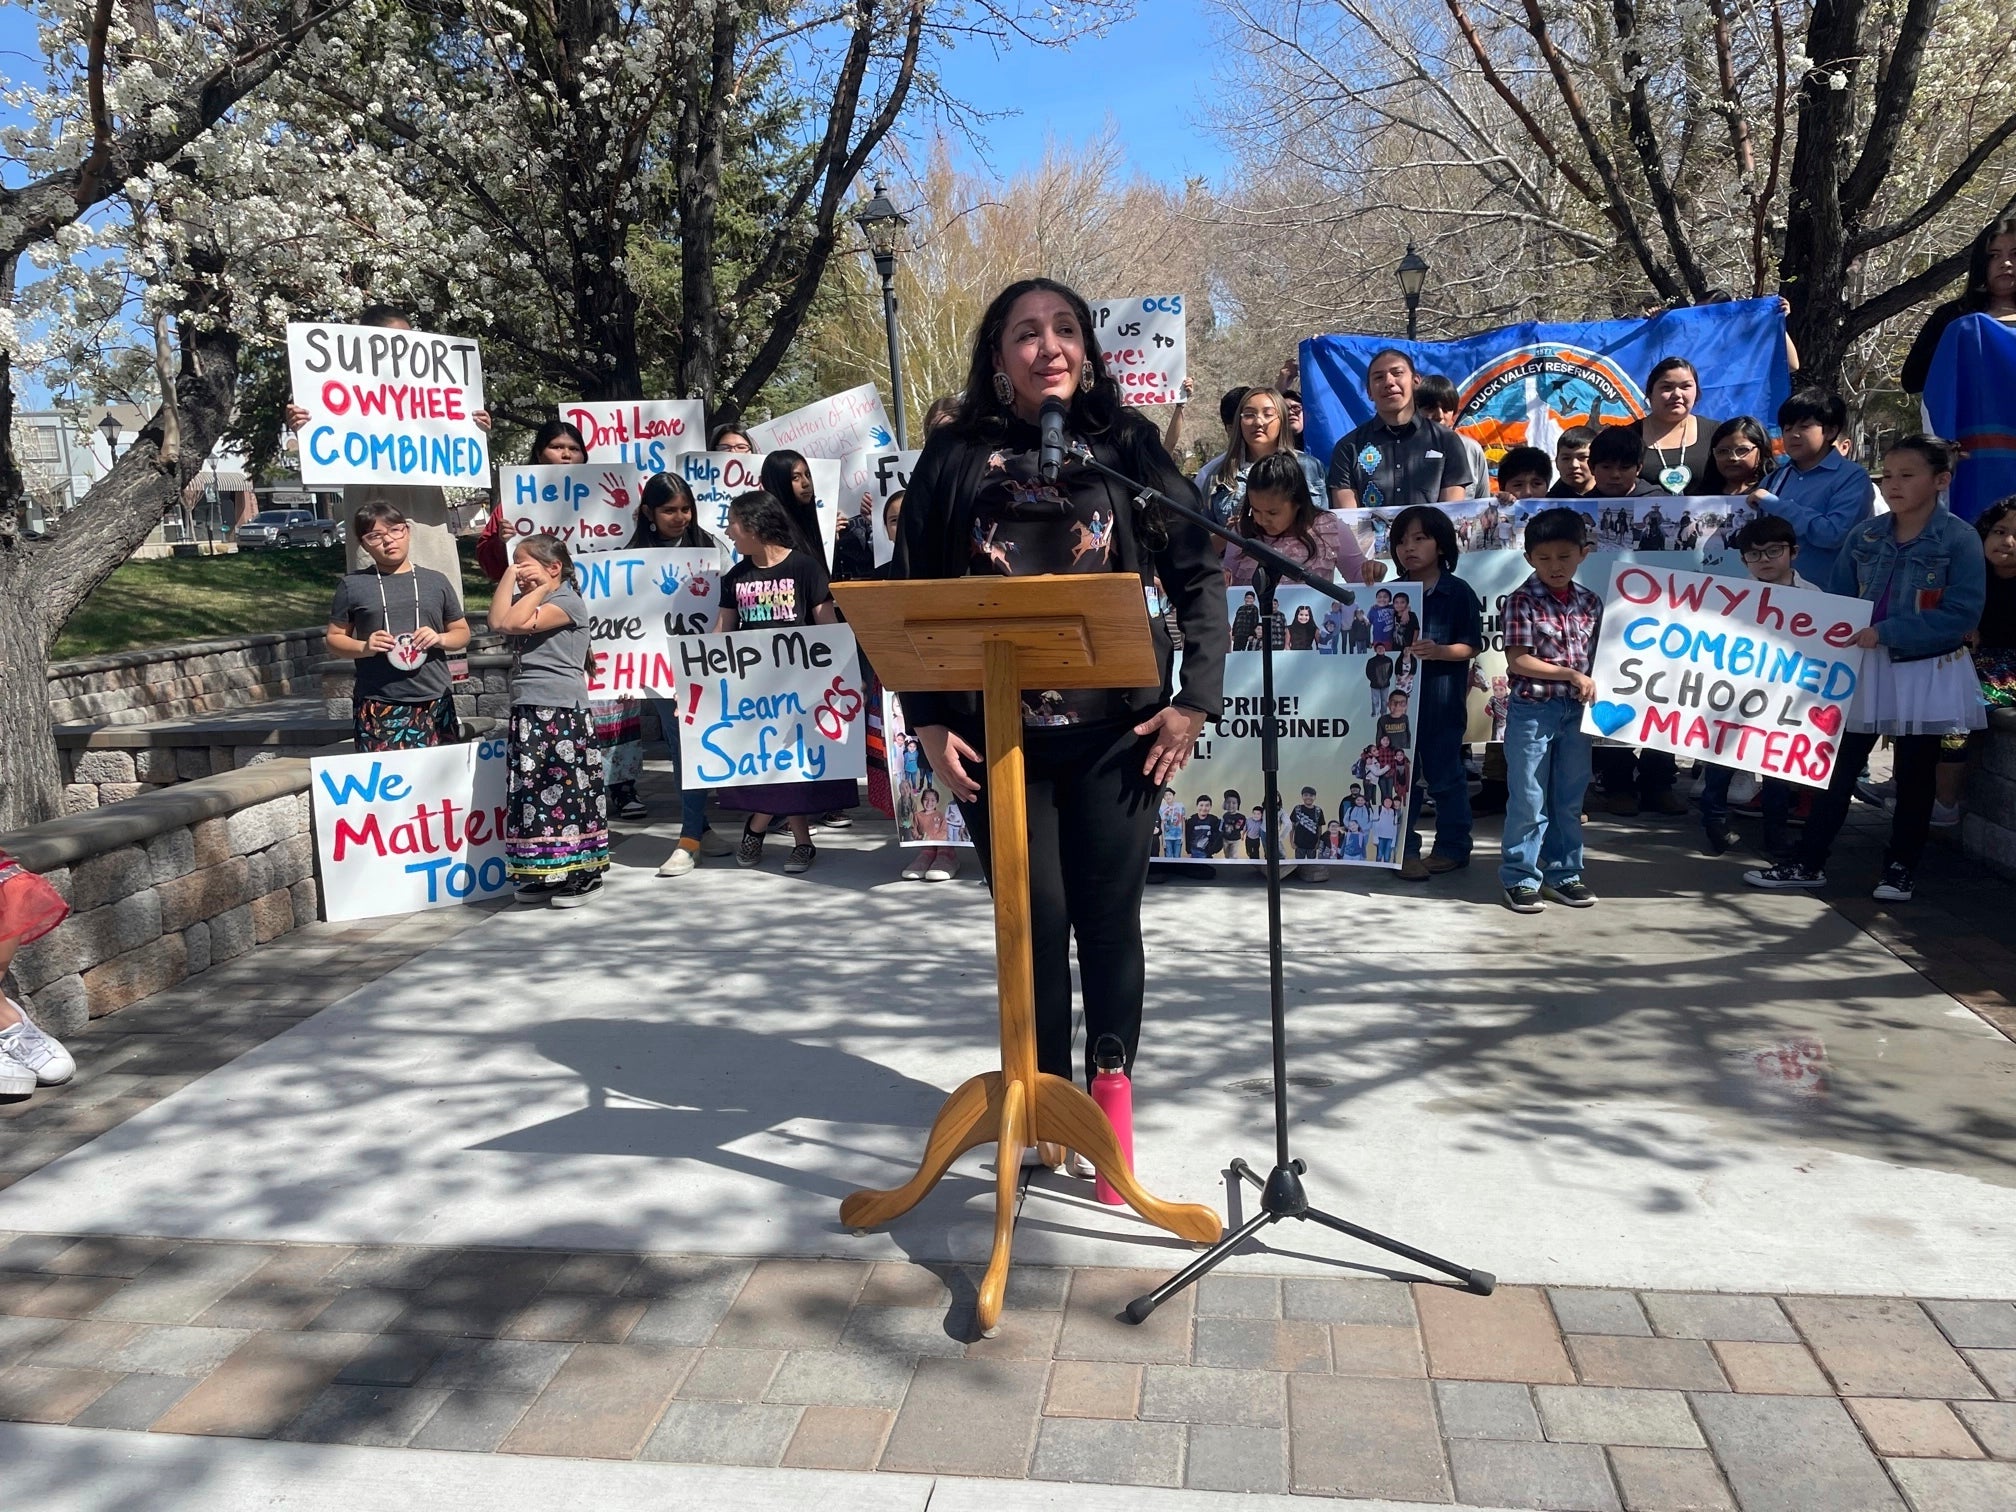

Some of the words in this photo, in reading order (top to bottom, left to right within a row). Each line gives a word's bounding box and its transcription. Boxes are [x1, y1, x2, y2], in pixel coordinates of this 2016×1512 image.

[1142, 296, 1182, 315] OCS
[305, 329, 476, 386] SUPPORT
[1152, 333, 1175, 348] to
[321, 380, 466, 421] OWYHEE
[1121, 389, 1175, 404] ceed!
[1470, 380, 1502, 410] DUCK
[1500, 362, 1543, 384] VALLEY
[1545, 361, 1617, 399] RESERVATION
[633, 406, 685, 439] Leave
[765, 416, 826, 447] Tradition
[828, 397, 844, 427] of
[842, 393, 876, 419] Pride
[310, 425, 483, 477] COMBINED
[684, 455, 720, 486] Help
[516, 473, 590, 511] Help
[515, 517, 624, 542] Owyhee
[736, 578, 795, 595] INCREASE
[758, 589, 796, 606] PEACE
[738, 604, 772, 621] VERY
[680, 635, 762, 679] Help
[773, 631, 832, 669] Me
[1623, 616, 1857, 701] COMBINED
[720, 678, 806, 722] Learn
[814, 675, 863, 740] OCS
[1612, 657, 1802, 727] SCHOOL
[698, 720, 826, 782] Safely
[1639, 706, 1835, 781] MATTERS
[320, 761, 412, 806] We
[333, 799, 508, 862] Matter
[405, 856, 512, 903] TOO
